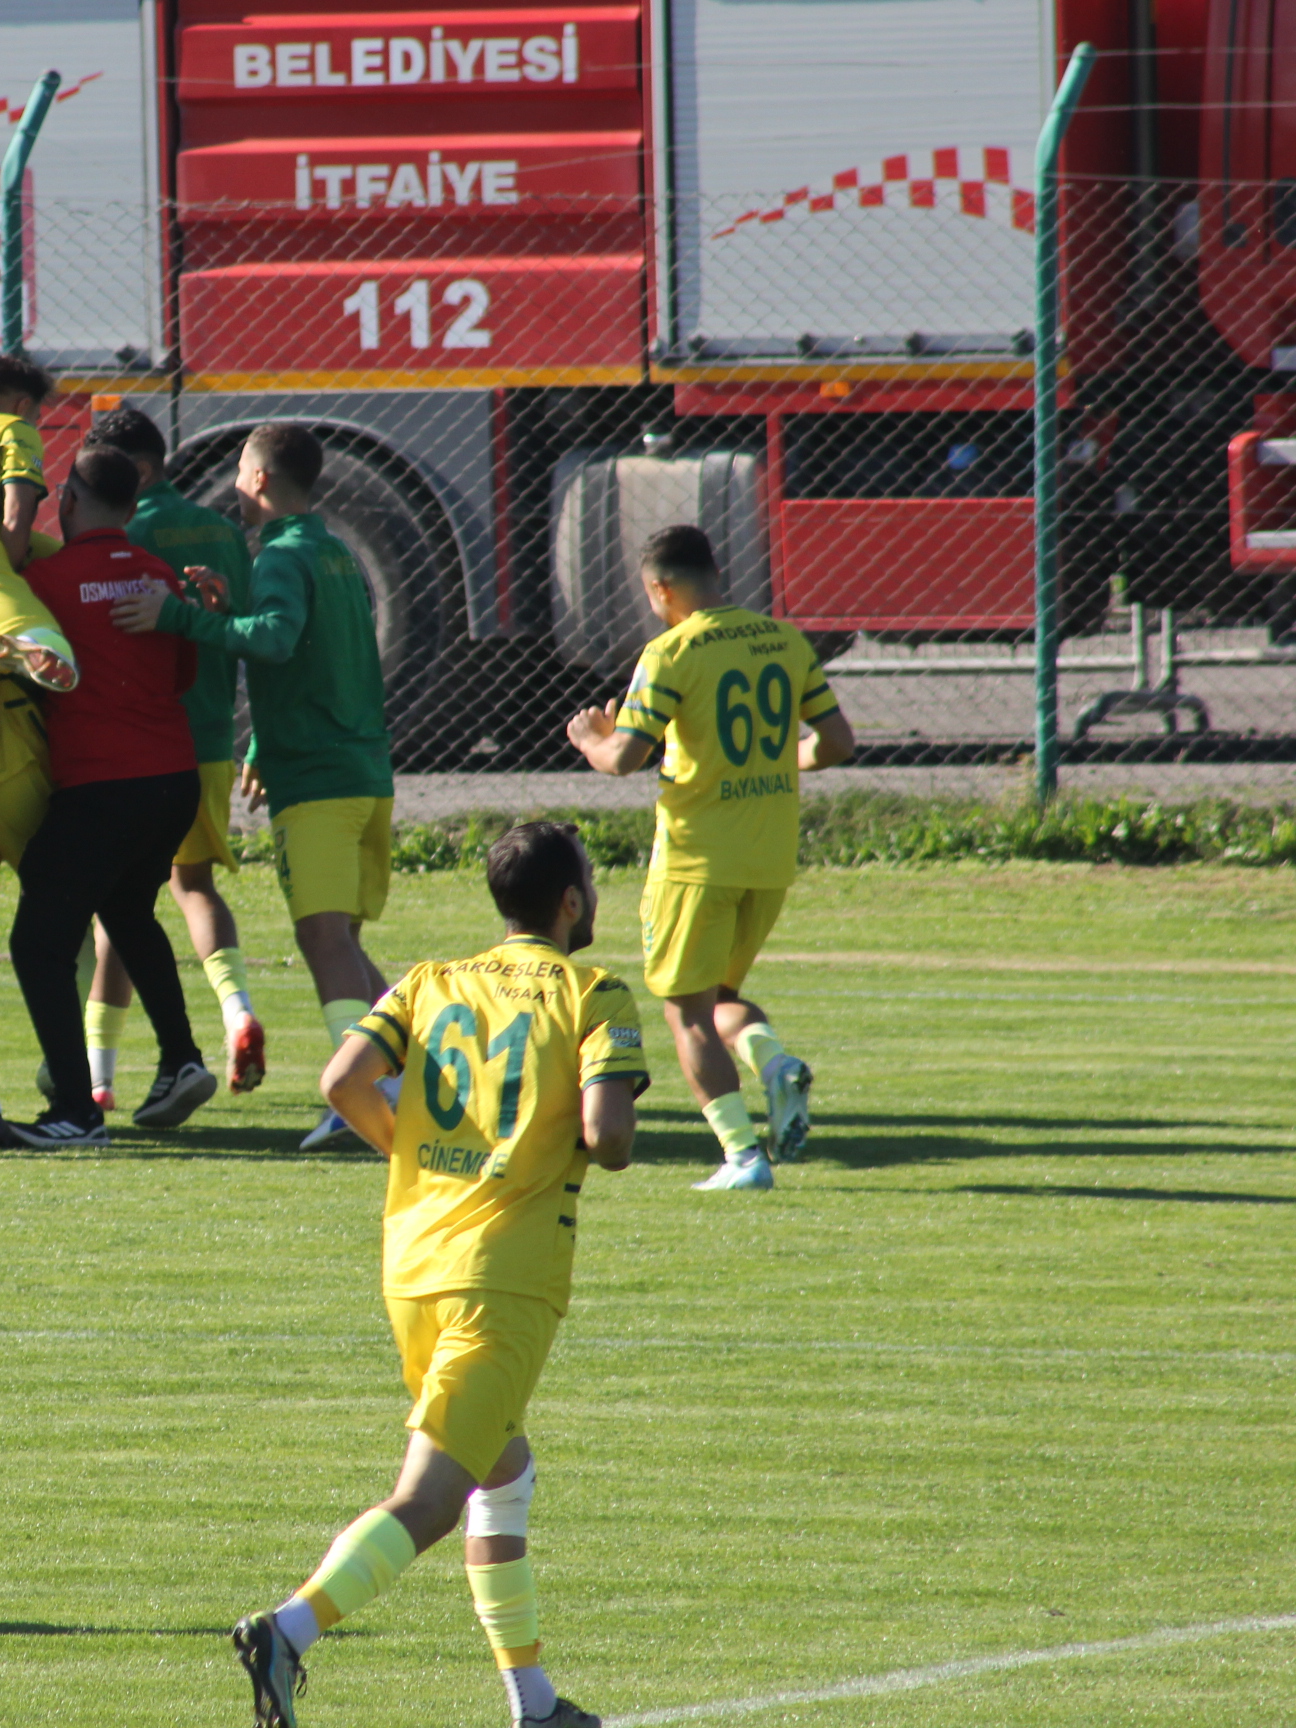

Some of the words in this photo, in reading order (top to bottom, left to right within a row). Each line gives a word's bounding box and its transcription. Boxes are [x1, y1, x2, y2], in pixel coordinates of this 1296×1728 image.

[234, 22, 578, 88] BELEDİYESİ
[295, 151, 519, 210] İTFAİYE
[343, 279, 491, 350] 112
[689, 620, 781, 650] KARDEŞLER
[716, 663, 792, 767] 69
[442, 960, 565, 981] KARDEŞLER
[493, 983, 557, 1005] İNŞAAT
[423, 1003, 533, 1138] 61
